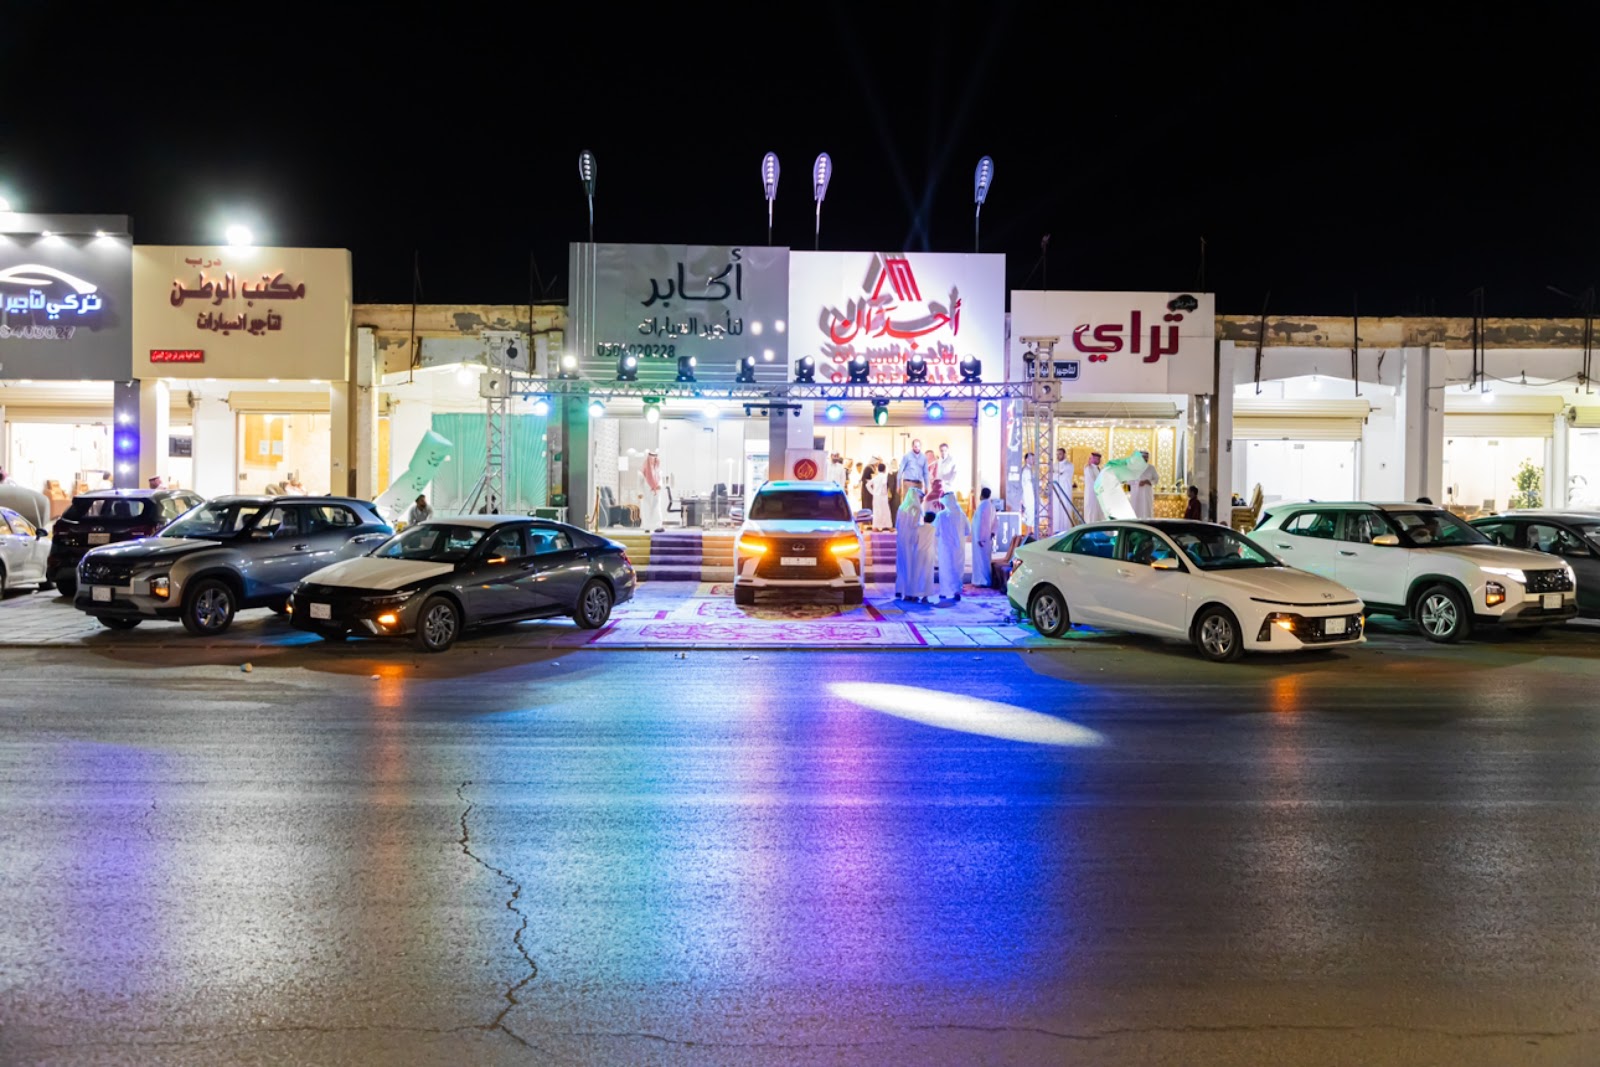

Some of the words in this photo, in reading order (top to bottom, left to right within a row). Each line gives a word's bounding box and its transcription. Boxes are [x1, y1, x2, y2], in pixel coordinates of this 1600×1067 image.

[170, 271, 236, 307] الوطن
[242, 272, 305, 307] مكتب
[641, 248, 742, 308] أكابر
[46, 294, 102, 320] تركي
[196, 311, 247, 336] السيارات
[1072, 310, 1183, 363] تراي
